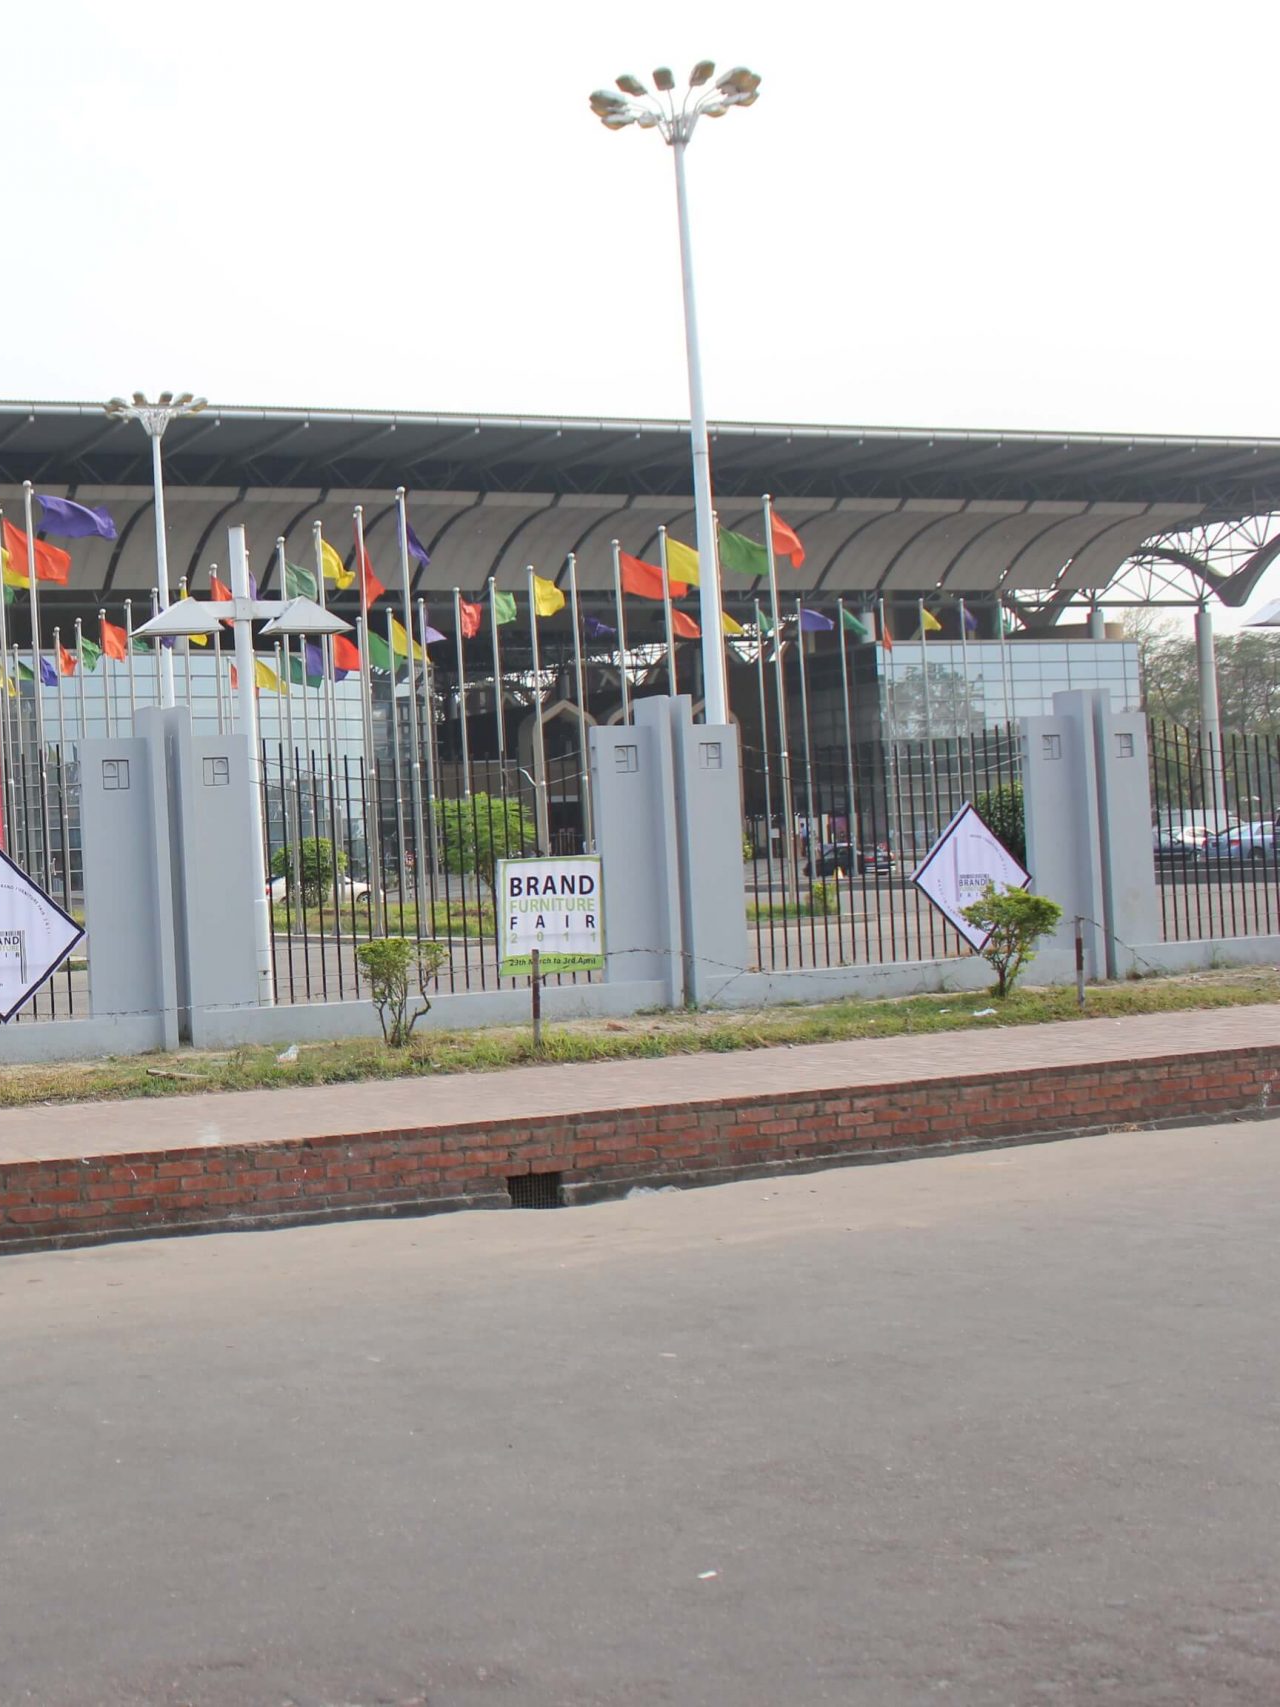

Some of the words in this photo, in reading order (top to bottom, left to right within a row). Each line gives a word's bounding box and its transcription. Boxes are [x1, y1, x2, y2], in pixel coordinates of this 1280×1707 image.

[510, 875, 595, 897] BRAND
[959, 878, 986, 887] BRAND
[510, 898, 595, 913] FURNITURE
[510, 914, 595, 930] FAIR
[510, 932, 596, 944] 2011
[527, 957, 552, 966] Mrch
[553, 957, 561, 965] to
